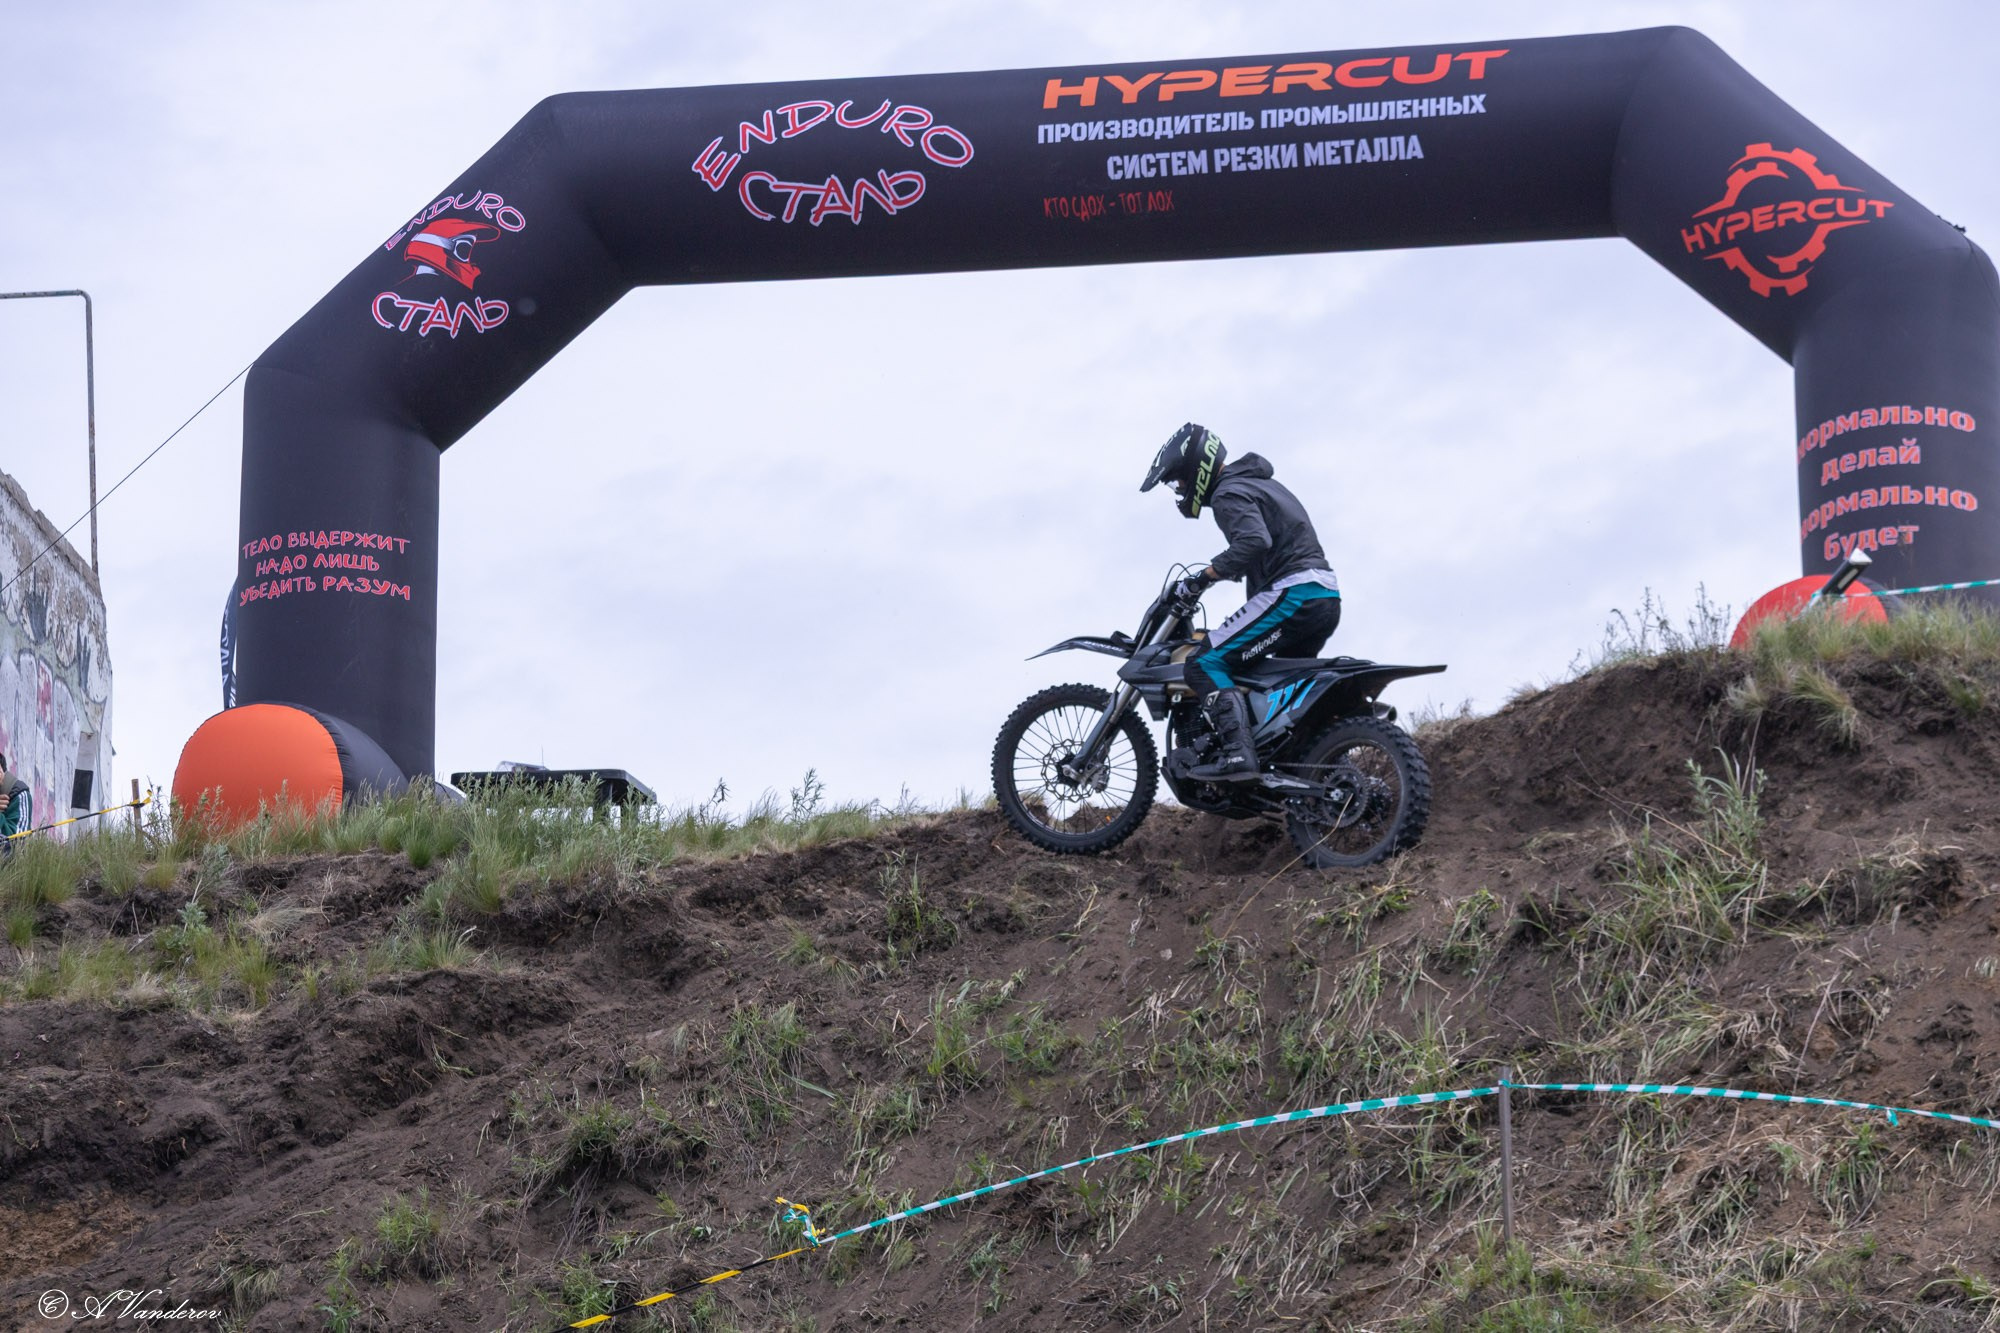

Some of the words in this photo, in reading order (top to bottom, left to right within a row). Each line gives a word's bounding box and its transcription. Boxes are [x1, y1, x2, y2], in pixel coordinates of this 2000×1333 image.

[1042, 49, 1510, 109] HYPERCUT
[1038, 111, 1254, 144] ПРОИЗВОДИТЕЛЬ
[1261, 94, 1487, 128] ПРОМЫШЛЕННЫХ
[692, 98, 975, 191] ENDURO
[1106, 149, 1209, 181] СИСТЕМ
[1214, 143, 1299, 173] РЕЗКИ
[1303, 135, 1424, 167] МЕТАЛЛА
[384, 190, 526, 251] ENDURO
[1043, 196, 1069, 219] КТО
[1071, 194, 1107, 222] СДОХ
[1118, 192, 1143, 213] ТОТ
[1147, 190, 1175, 211] ЛОХ
[1680, 198, 1895, 253] HYPERCUT
[1820, 438, 1921, 486] делай
[242, 534, 283, 559] ТЕЛО
[287, 530, 411, 554] ВЫДЕРЖИТ
[255, 554, 307, 578] НАДО
[313, 553, 380, 572] ЛИШЬ
[1823, 525, 1920, 561] будет
[239, 576, 317, 607] УБЕДИТЬ
[322, 576, 411, 601] РАЗУМ
